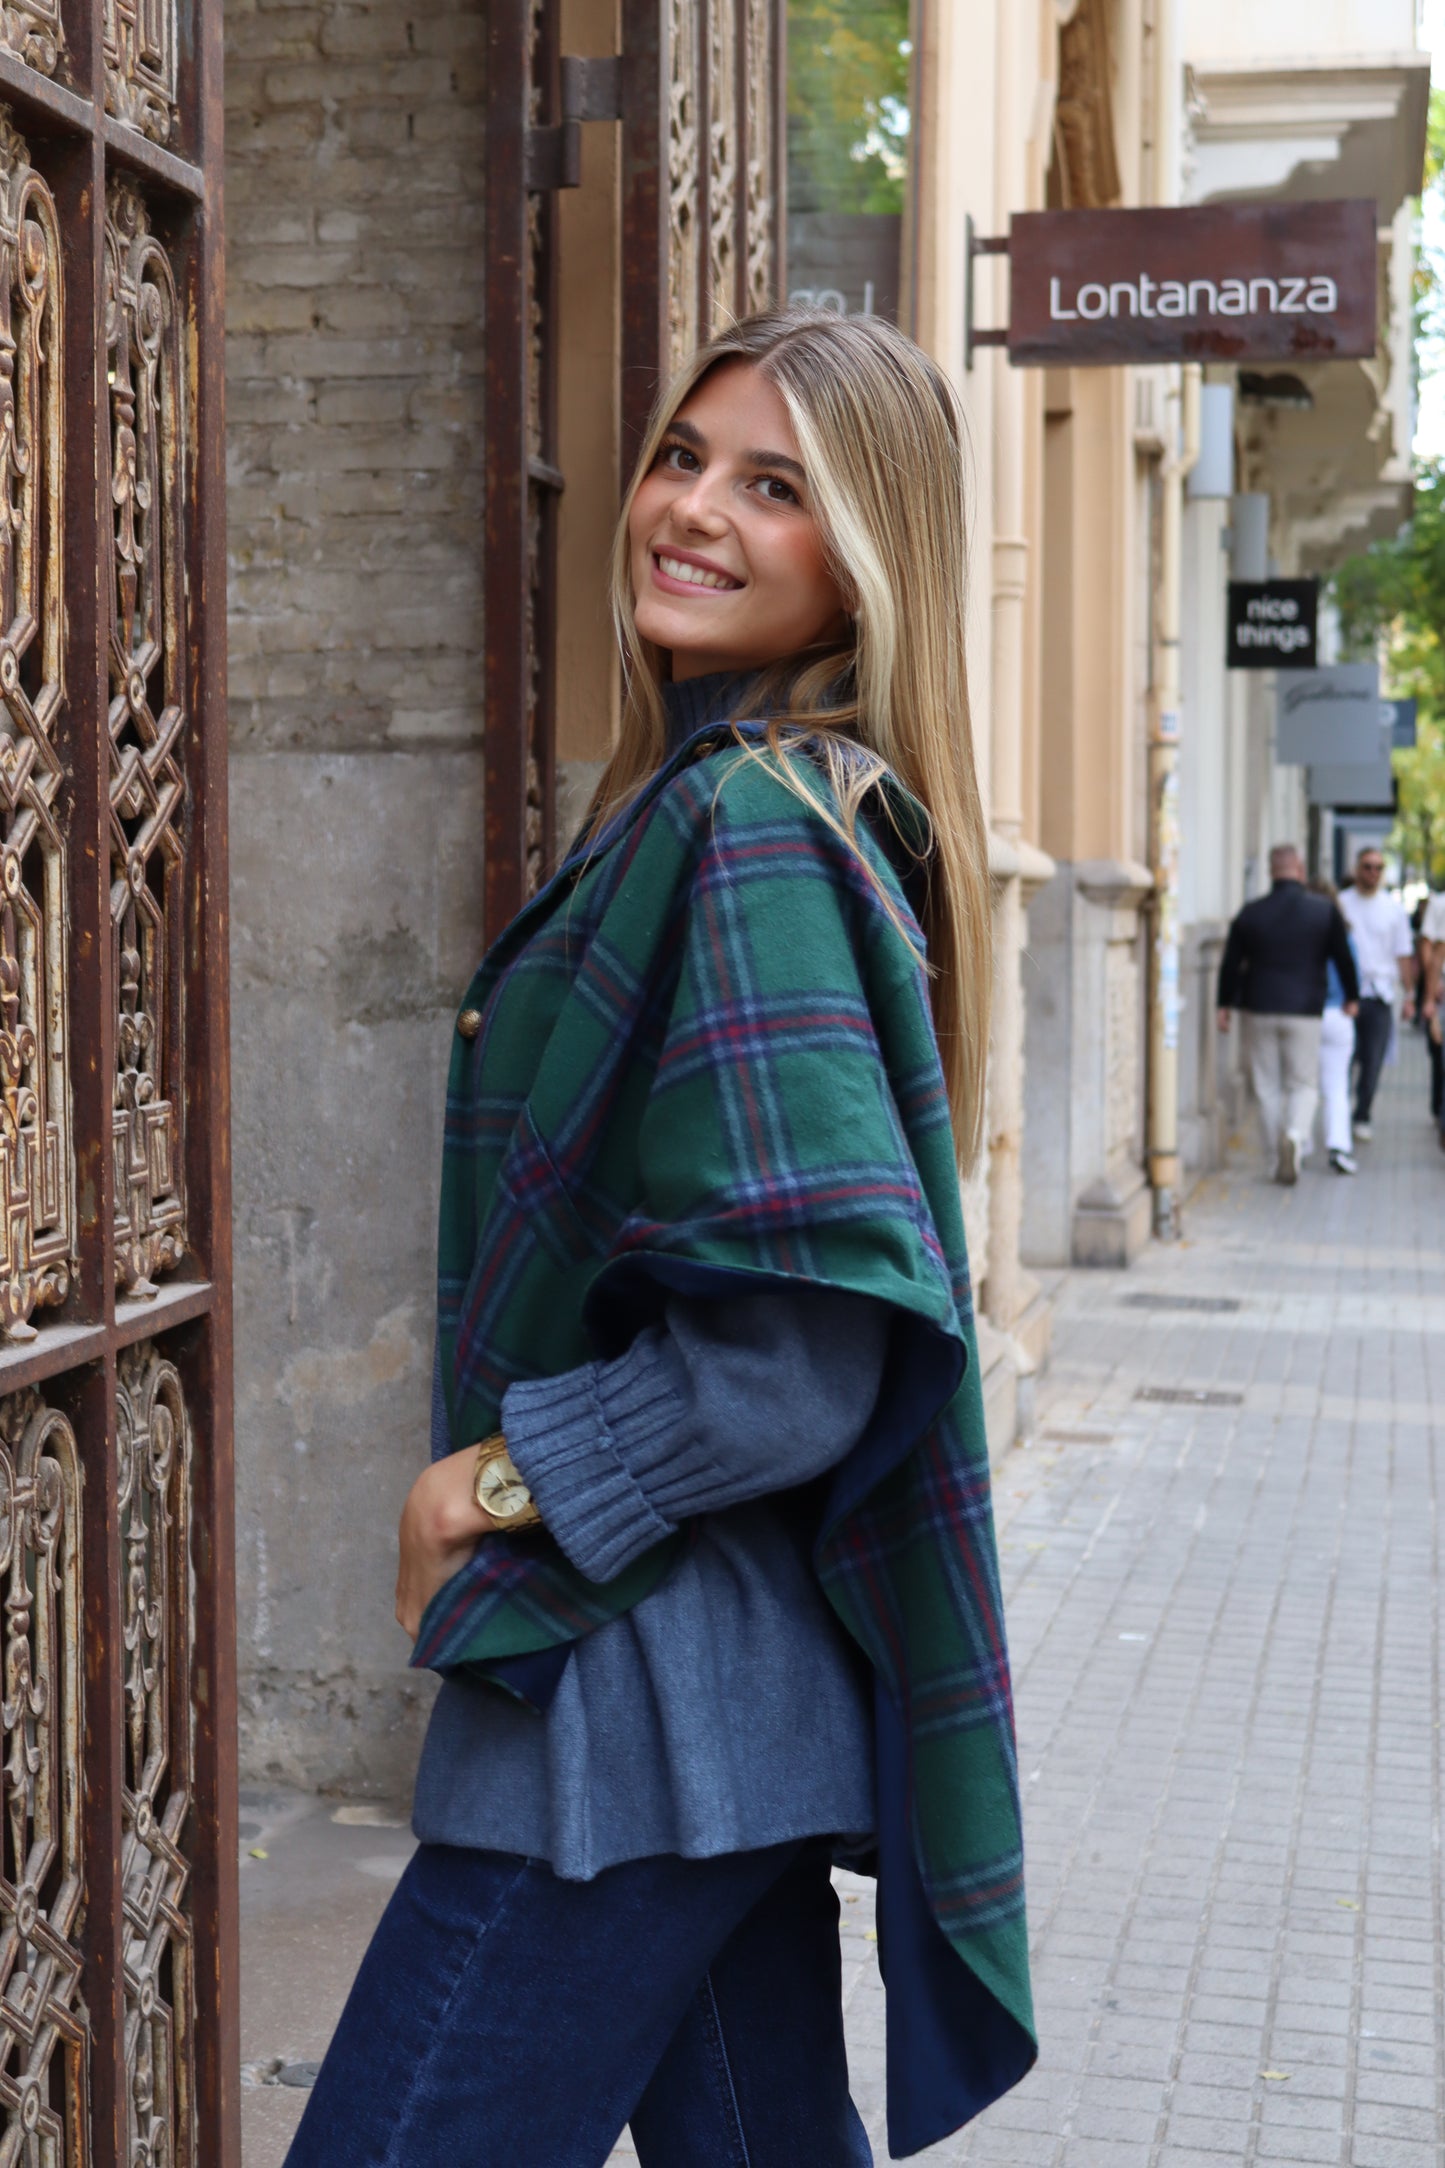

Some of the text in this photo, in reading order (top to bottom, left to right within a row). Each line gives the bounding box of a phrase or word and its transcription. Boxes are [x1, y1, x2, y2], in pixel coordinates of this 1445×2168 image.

[1050, 273, 1338, 320] Lontananza
[1247, 595, 1298, 621] nice
[1236, 623, 1310, 652] things
